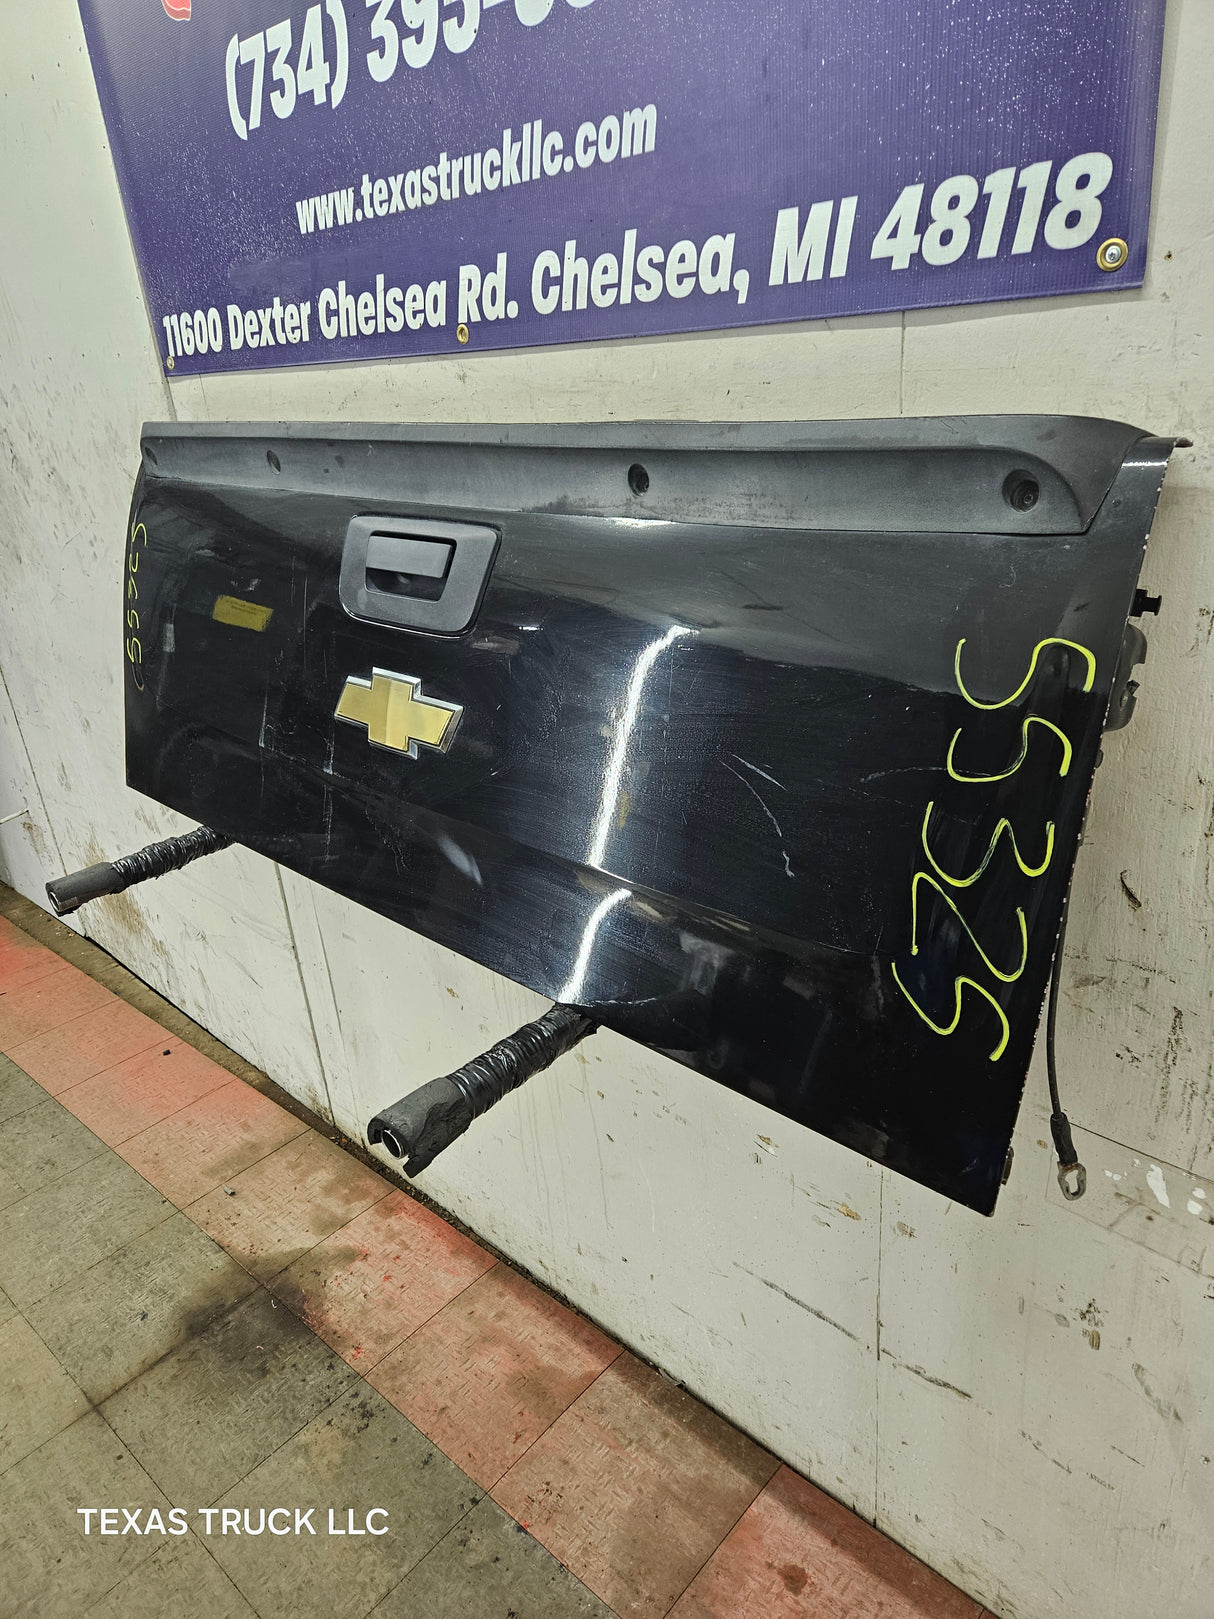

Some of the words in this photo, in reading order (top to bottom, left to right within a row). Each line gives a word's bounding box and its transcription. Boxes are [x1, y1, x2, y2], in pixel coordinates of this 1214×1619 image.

[225, 0, 349, 140] (734)
[295, 103, 657, 235] www.texastruckllc.com
[162, 307, 223, 357] 11600
[226, 301, 311, 350] Dexter
[317, 273, 447, 340] Chelsea
[458, 252, 519, 324] Rd.
[531, 228, 750, 315] Chelsea,
[768, 195, 858, 286] MI
[870, 152, 1113, 271] 48118
